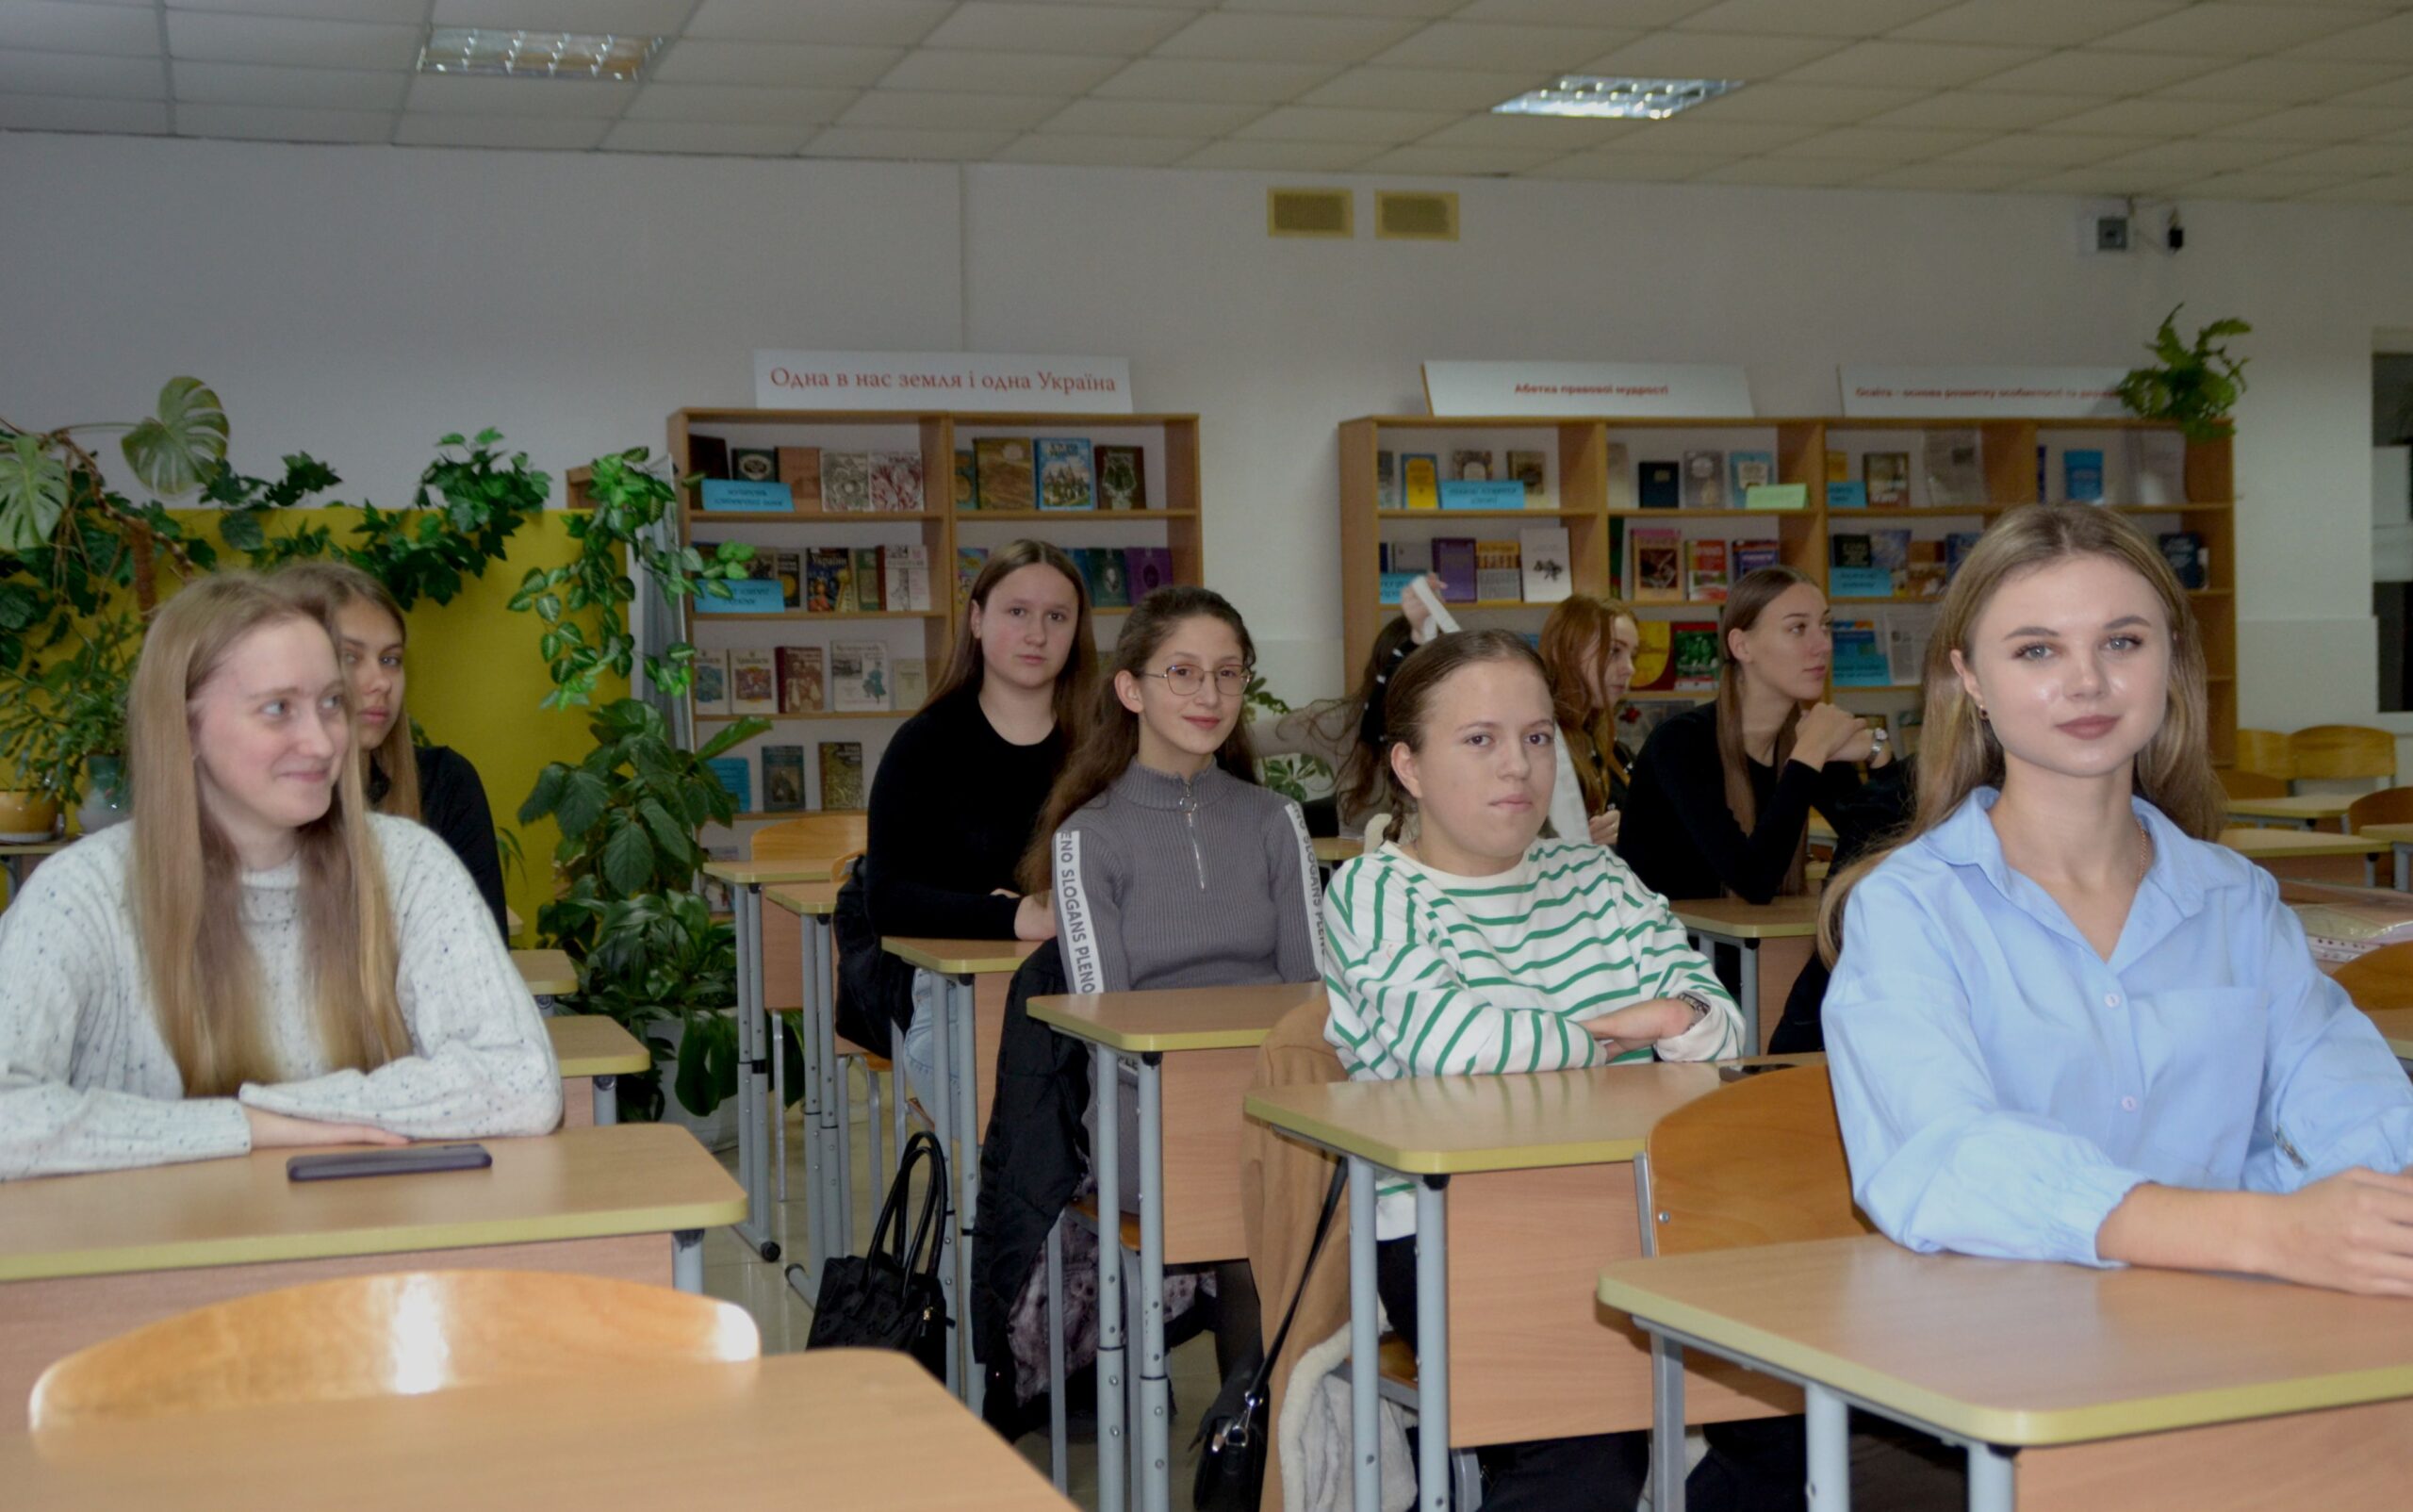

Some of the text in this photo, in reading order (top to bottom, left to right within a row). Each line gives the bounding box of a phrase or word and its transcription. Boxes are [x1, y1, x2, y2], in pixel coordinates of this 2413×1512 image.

[770, 367, 1117, 394] Одна в нас земля і одна Україна
[1304, 835, 1322, 907] SLOGANS
[1061, 868, 1087, 943] SLOGANS
[1074, 945, 1096, 994] PLENO
